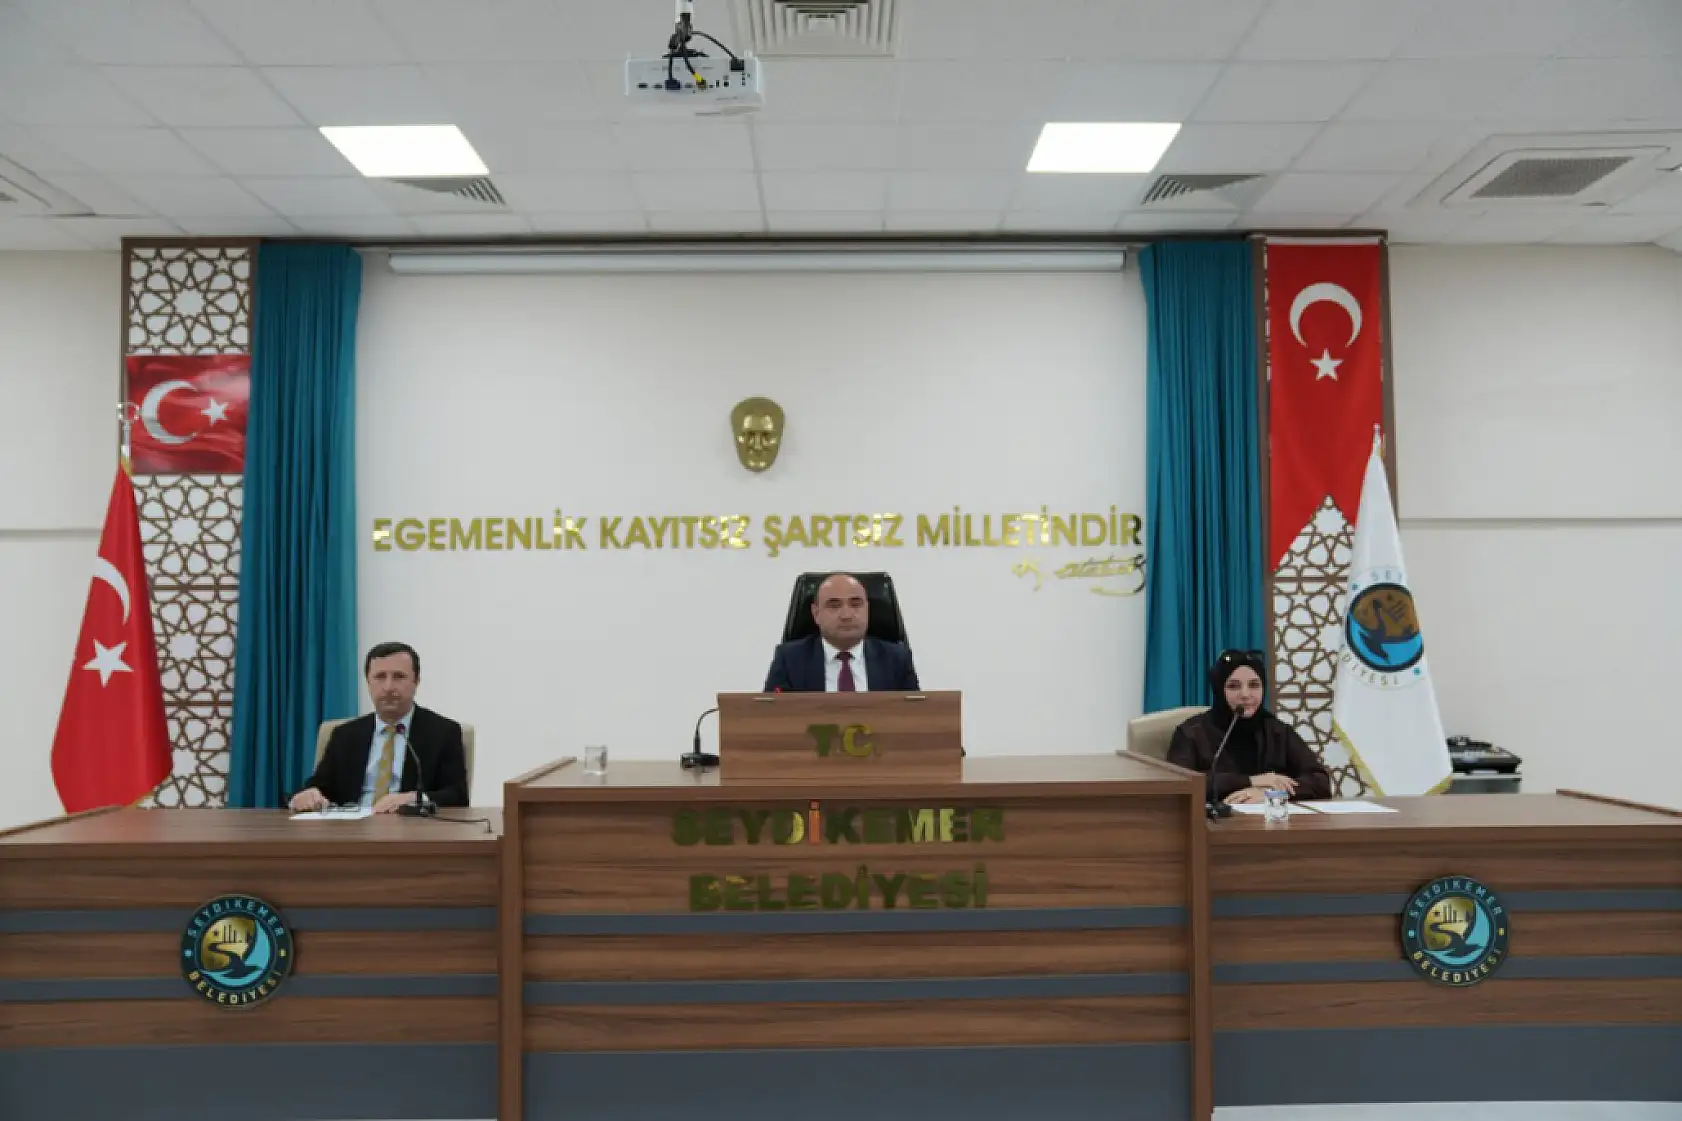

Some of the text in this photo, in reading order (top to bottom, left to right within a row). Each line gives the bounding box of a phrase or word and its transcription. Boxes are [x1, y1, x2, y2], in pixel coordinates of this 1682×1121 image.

[373, 508, 588, 552] EGEMENLİK
[916, 504, 1142, 548] MİLLETİNDİR
[672, 800, 1005, 845] SEYDİKEMER
[689, 862, 989, 911] BELEDİYESİ
